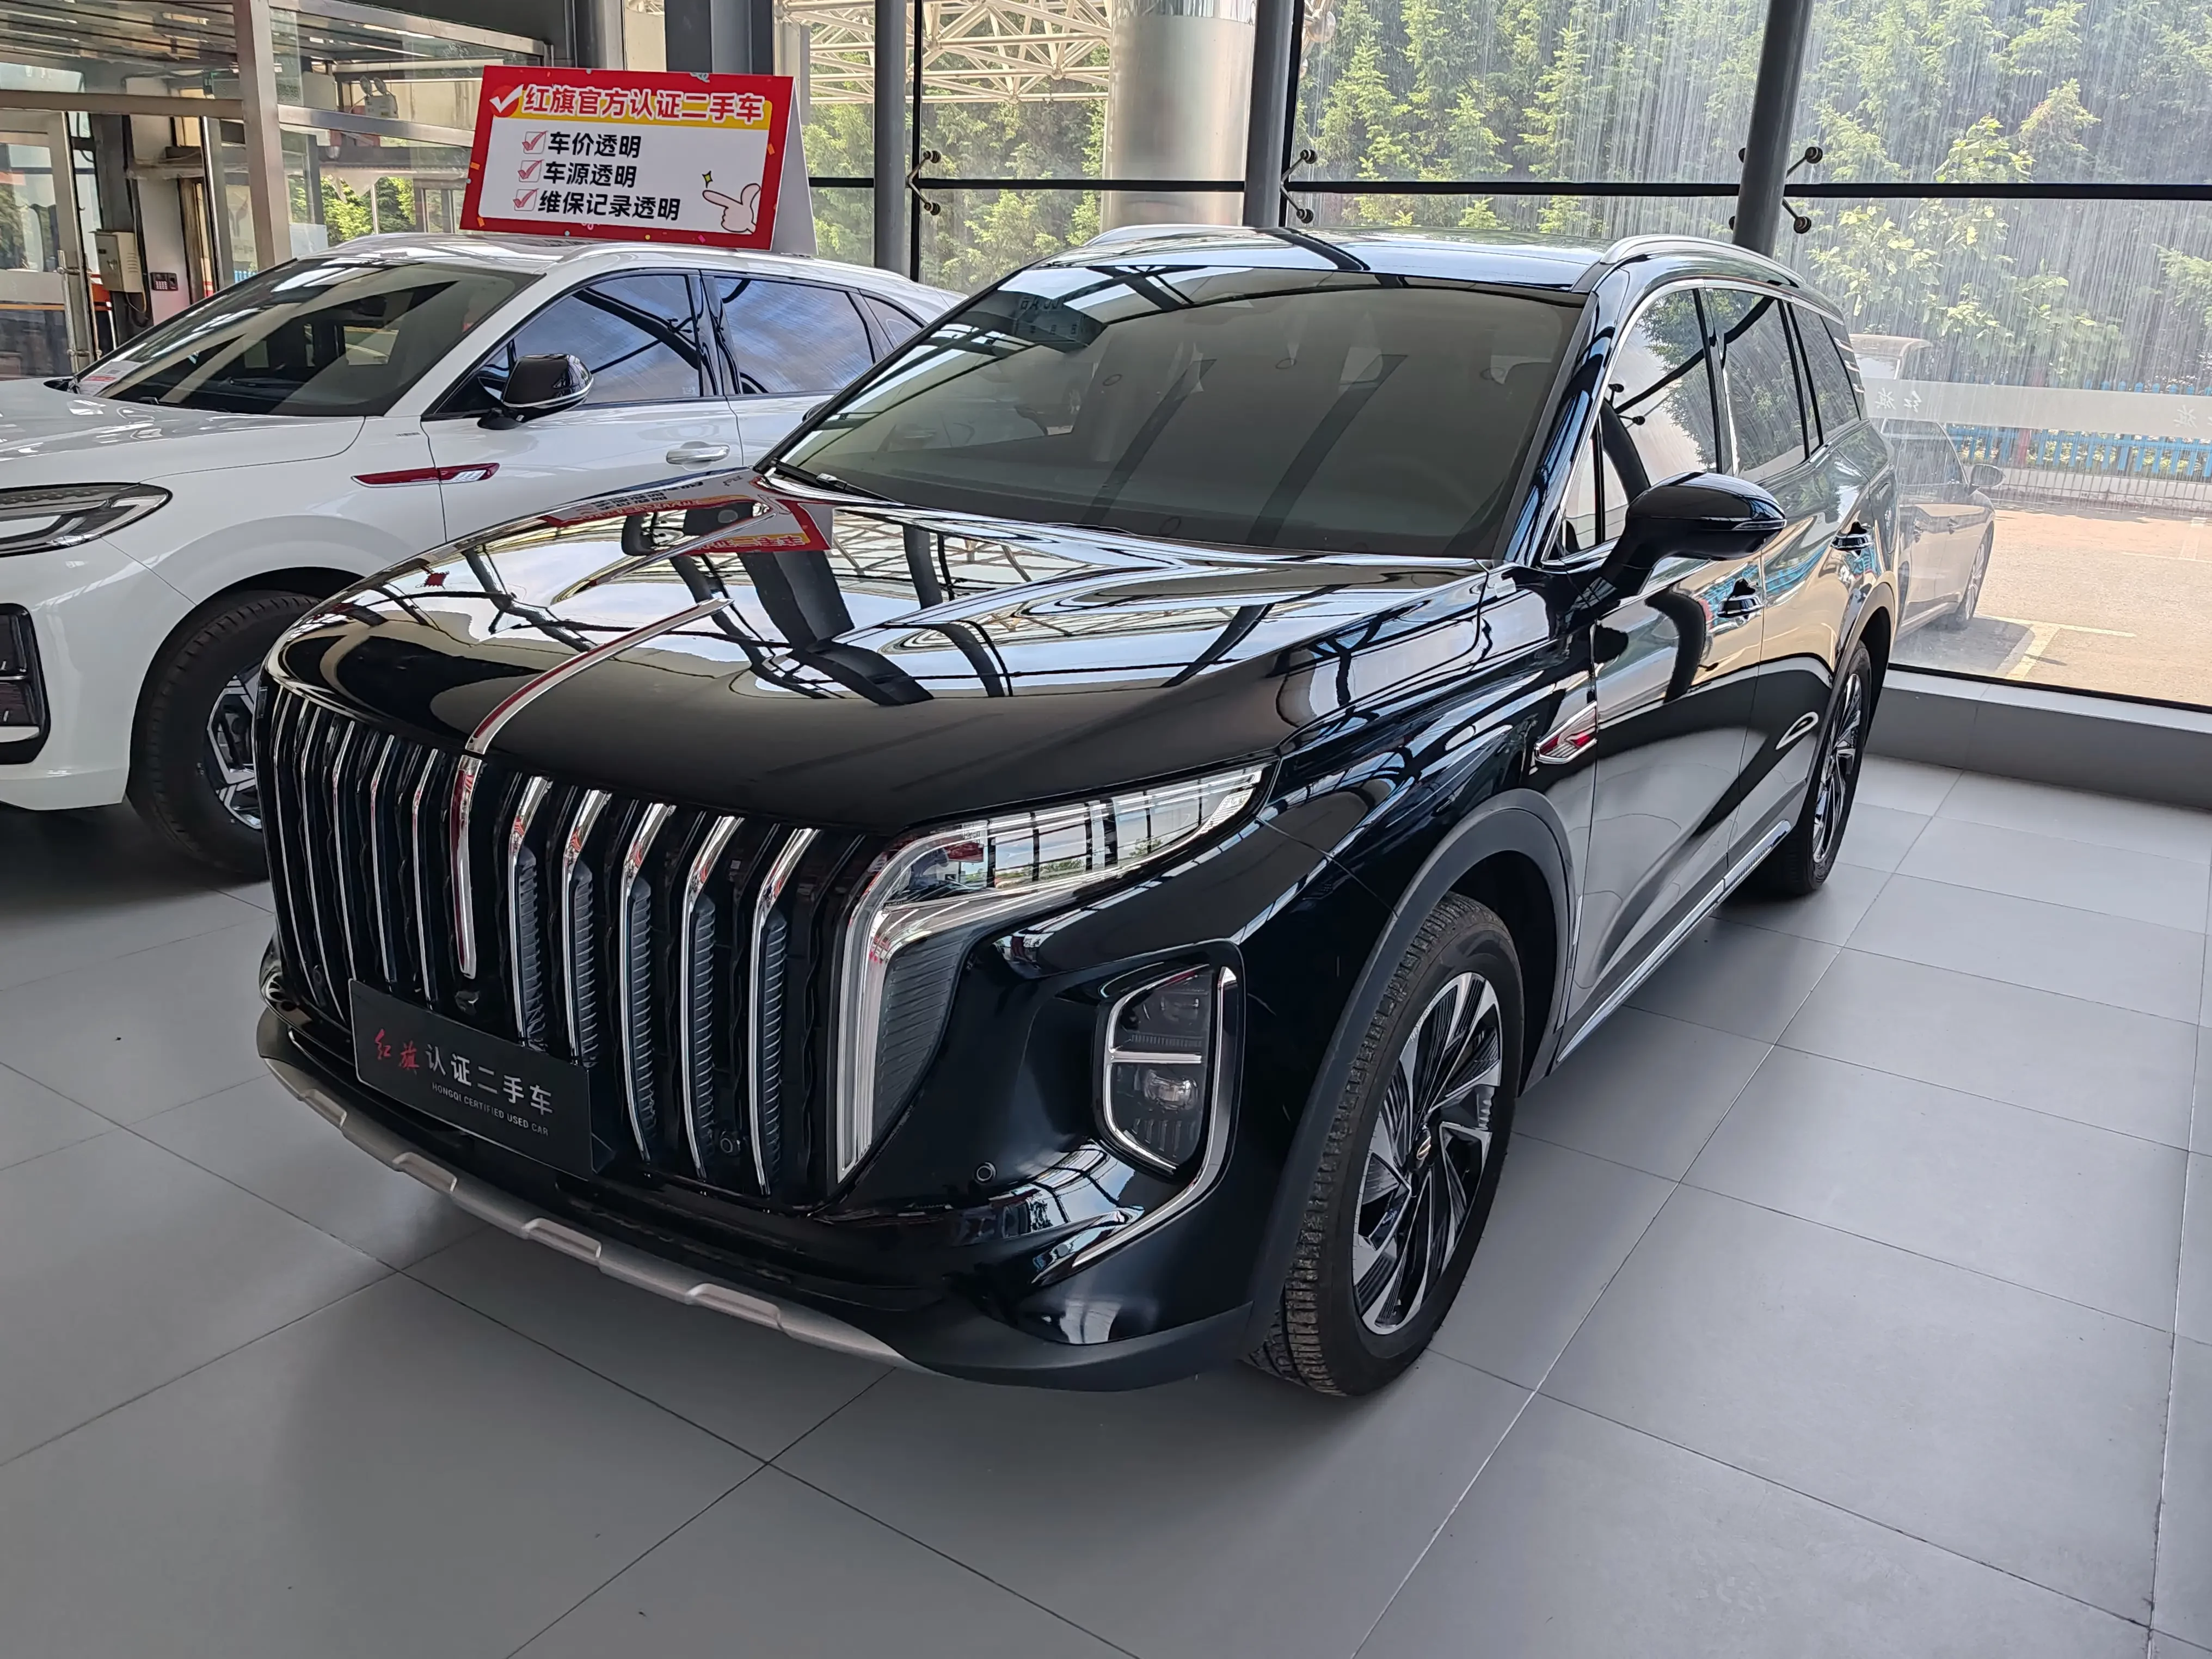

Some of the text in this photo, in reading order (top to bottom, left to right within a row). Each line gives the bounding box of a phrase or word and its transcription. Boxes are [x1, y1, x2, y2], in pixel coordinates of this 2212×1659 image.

[524, 84, 765, 123] 红旗官方认证二手车
[548, 131, 642, 158] 车价透明
[543, 161, 637, 188] 车源透明
[538, 190, 680, 221] 维保记录透明
[432, 1082, 549, 1136] HONGQI CERTIFIED USED CAR
